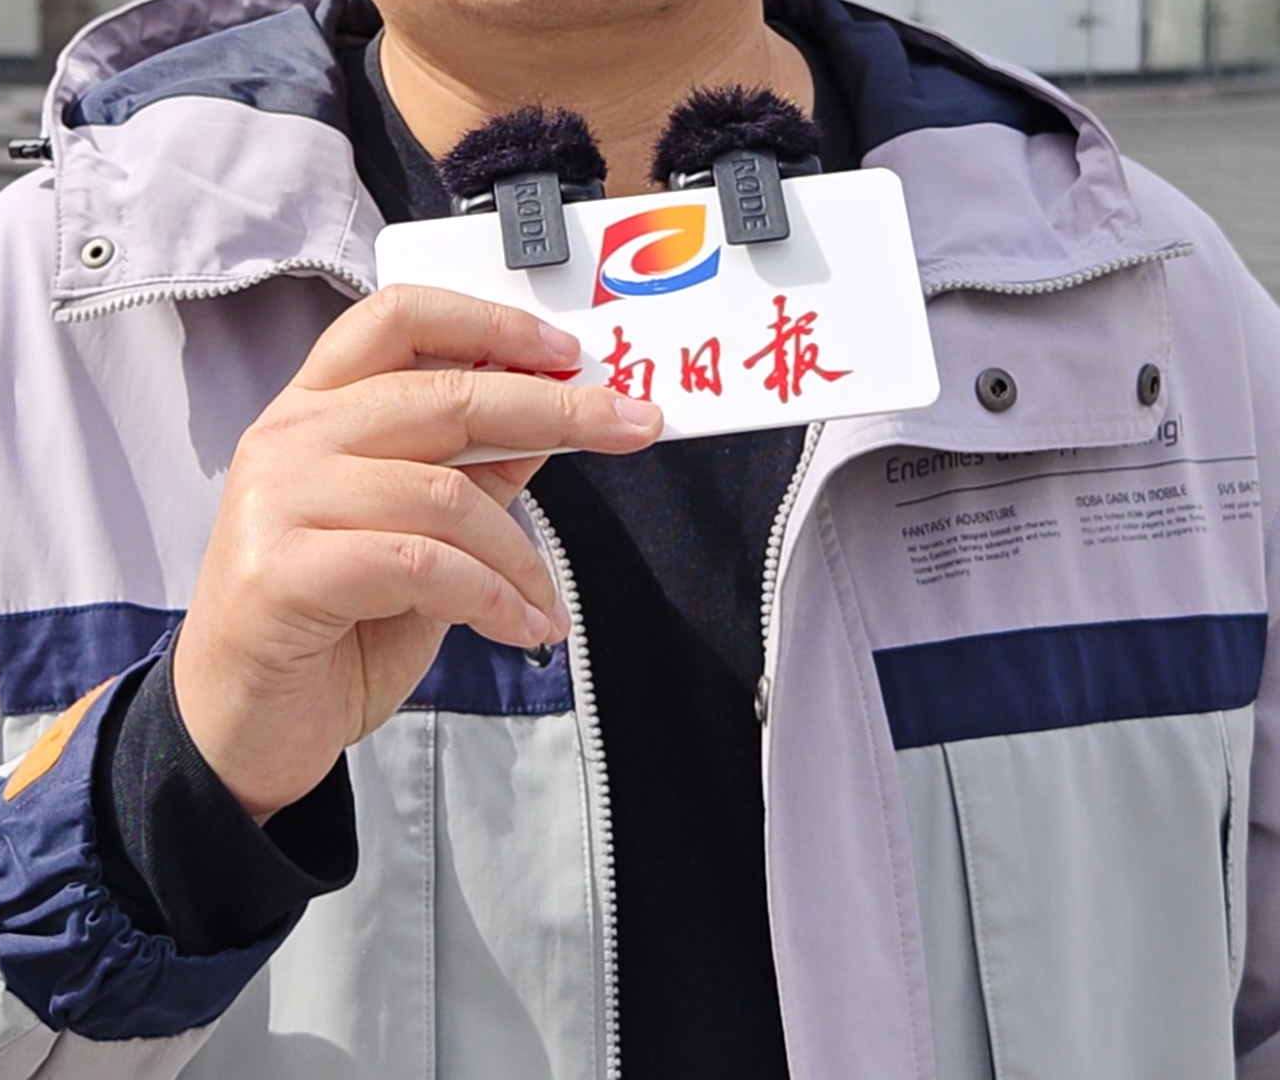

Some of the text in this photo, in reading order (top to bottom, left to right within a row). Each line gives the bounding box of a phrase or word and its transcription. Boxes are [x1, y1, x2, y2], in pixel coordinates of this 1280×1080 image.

[886, 450, 984, 484] Enemies
[1147, 483, 1188, 501] MOBILE
[902, 505, 1018, 539] FANTASY ADVENTURE
